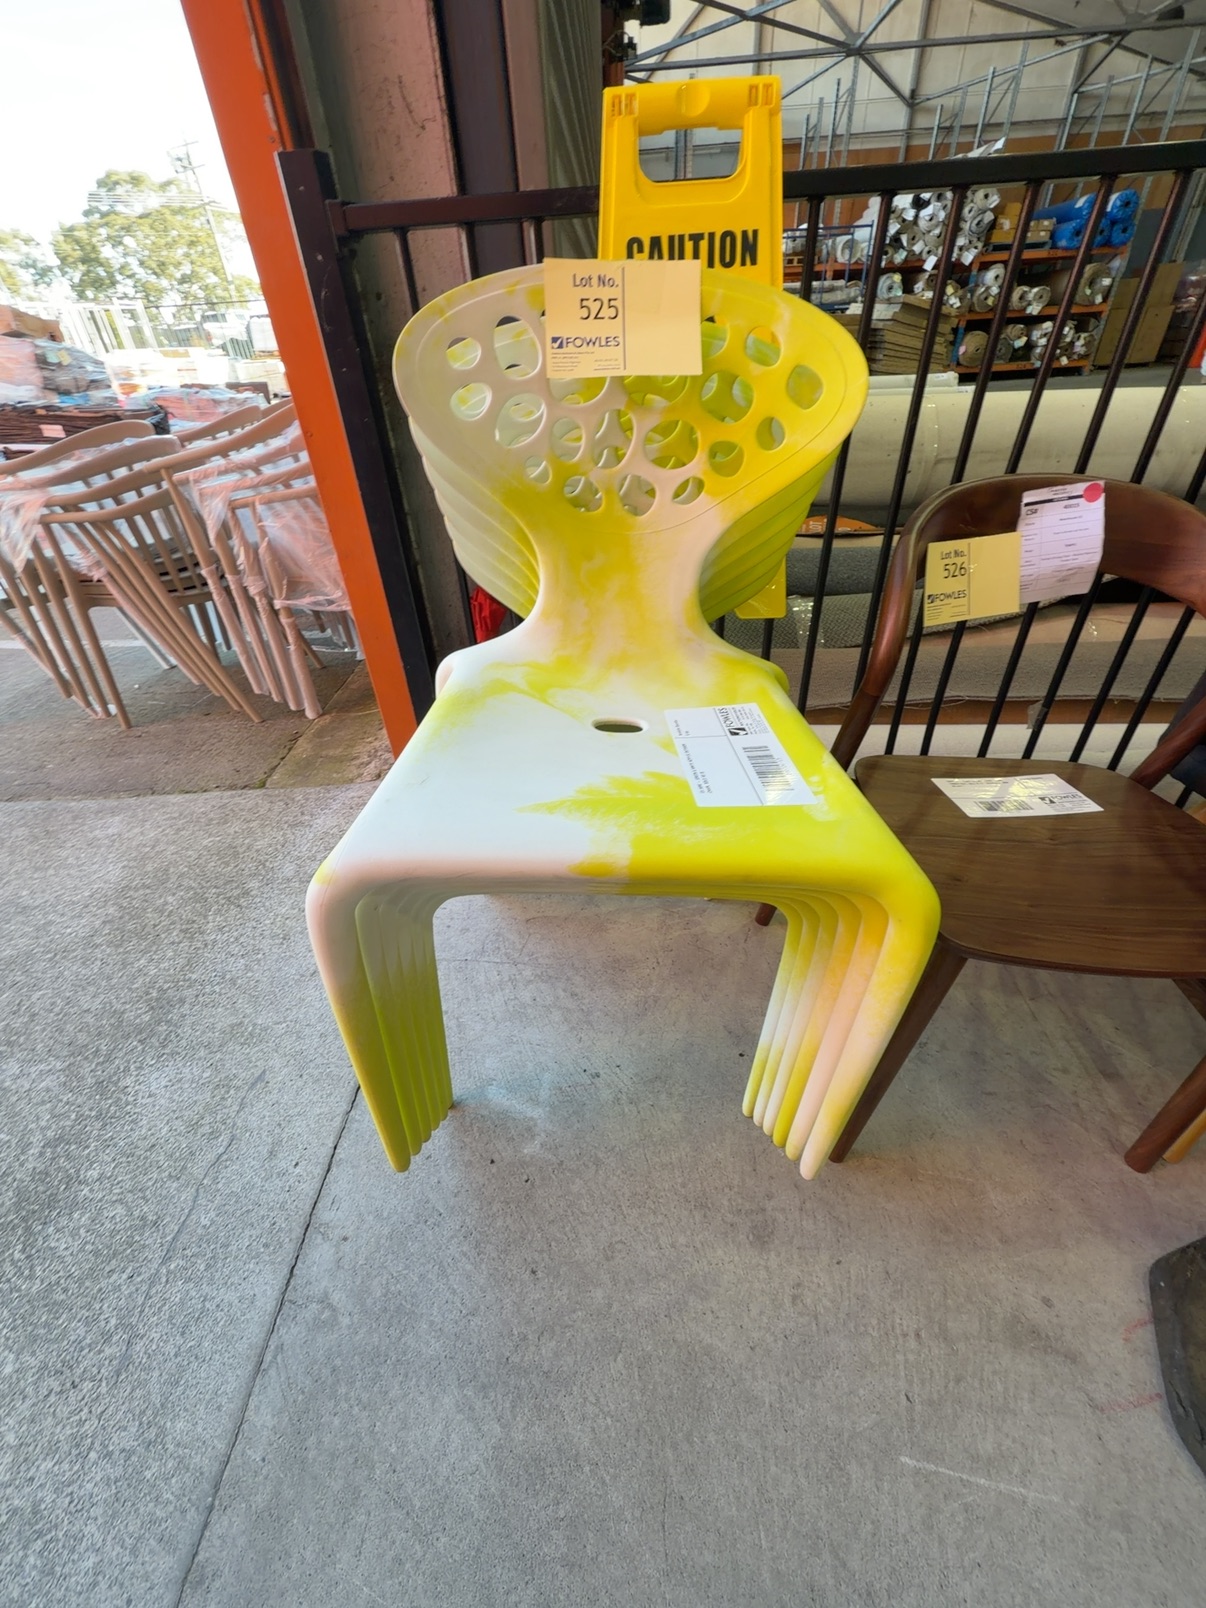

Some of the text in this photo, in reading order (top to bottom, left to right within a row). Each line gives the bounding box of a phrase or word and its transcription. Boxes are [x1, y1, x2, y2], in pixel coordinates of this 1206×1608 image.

[626, 229, 759, 269] CAUTION
[572, 273, 619, 288] Lot No.
[579, 298, 619, 320] 525
[565, 336, 620, 348] FOWLES
[940, 549, 967, 560] Lot No.
[944, 561, 967, 579] 526
[934, 589, 967, 602] FOWLES
[717, 707, 735, 728] FOWLES
